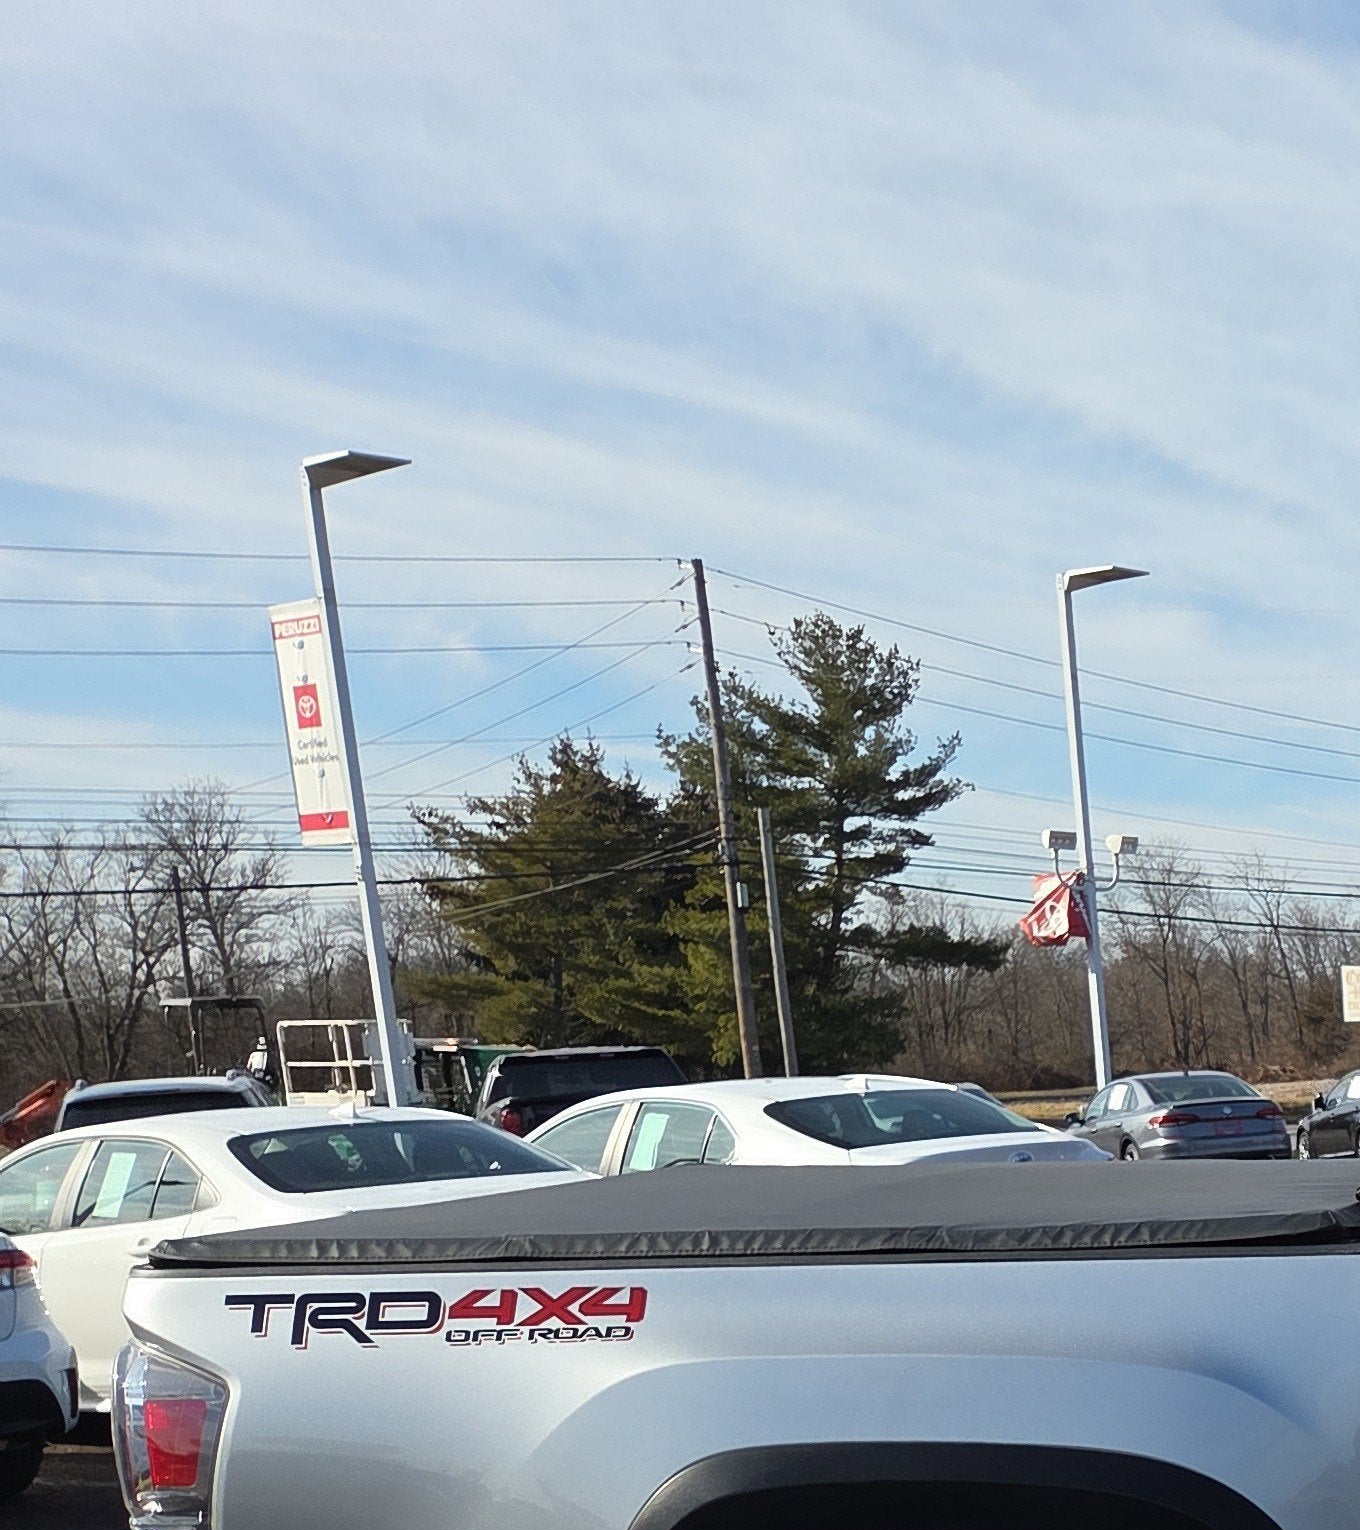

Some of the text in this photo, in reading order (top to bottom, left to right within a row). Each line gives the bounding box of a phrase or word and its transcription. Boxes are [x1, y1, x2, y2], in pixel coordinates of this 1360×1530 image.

[224, 1285, 648, 1349] TRD 4X4
[444, 1325, 636, 1347] OFF ROAD
